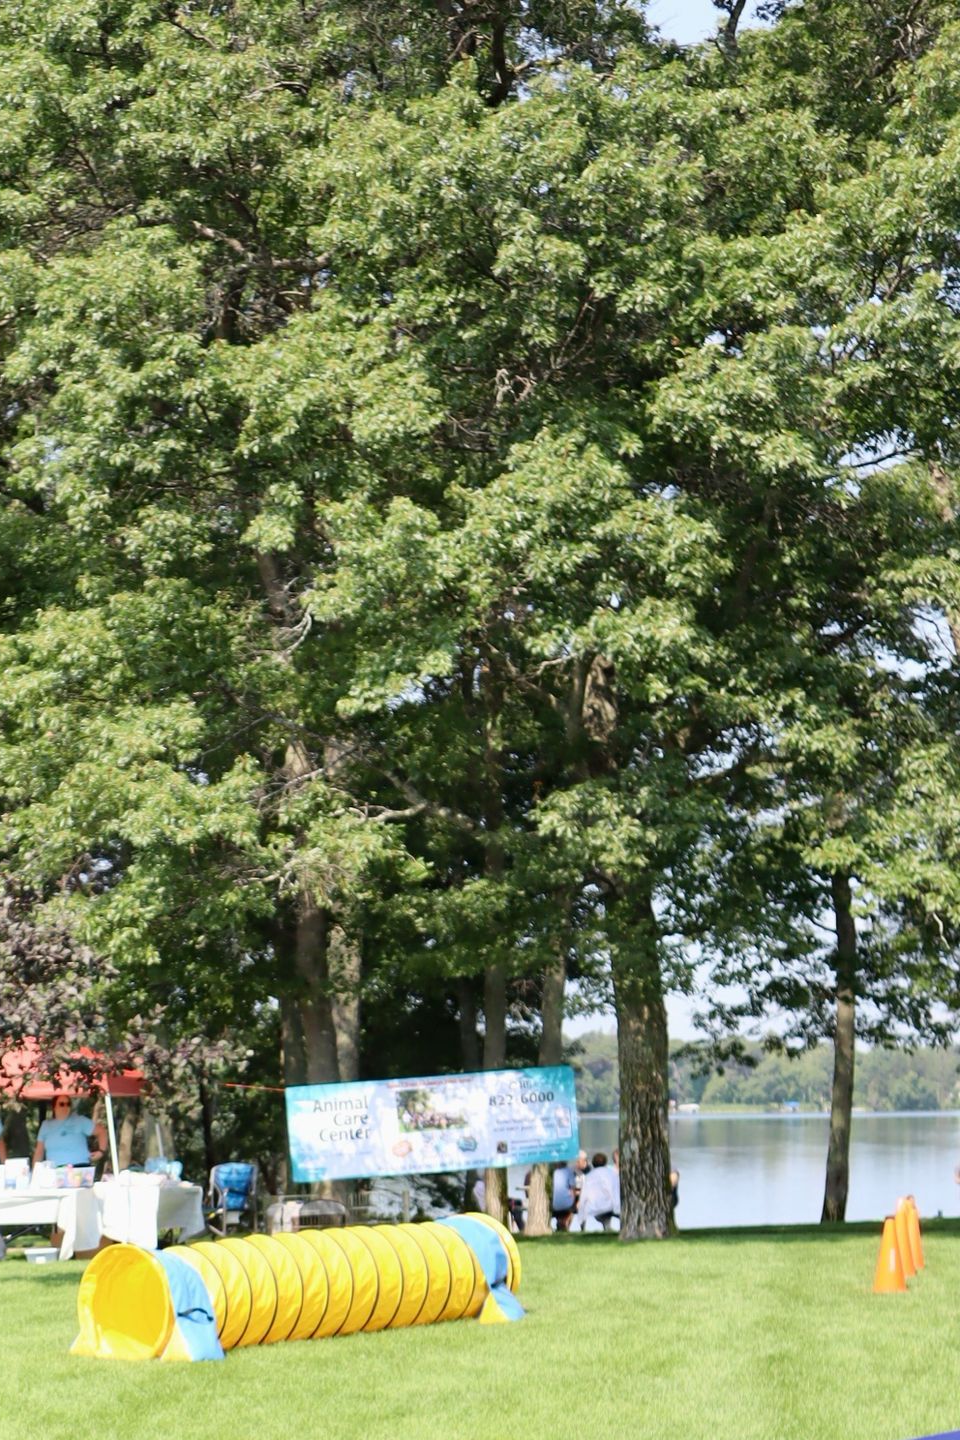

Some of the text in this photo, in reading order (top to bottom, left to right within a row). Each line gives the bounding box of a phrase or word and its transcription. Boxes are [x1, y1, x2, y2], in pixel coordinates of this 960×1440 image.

[313, 1094, 369, 1113] Animal
[332, 1112, 370, 1127] Care
[318, 1127, 371, 1142] Center
